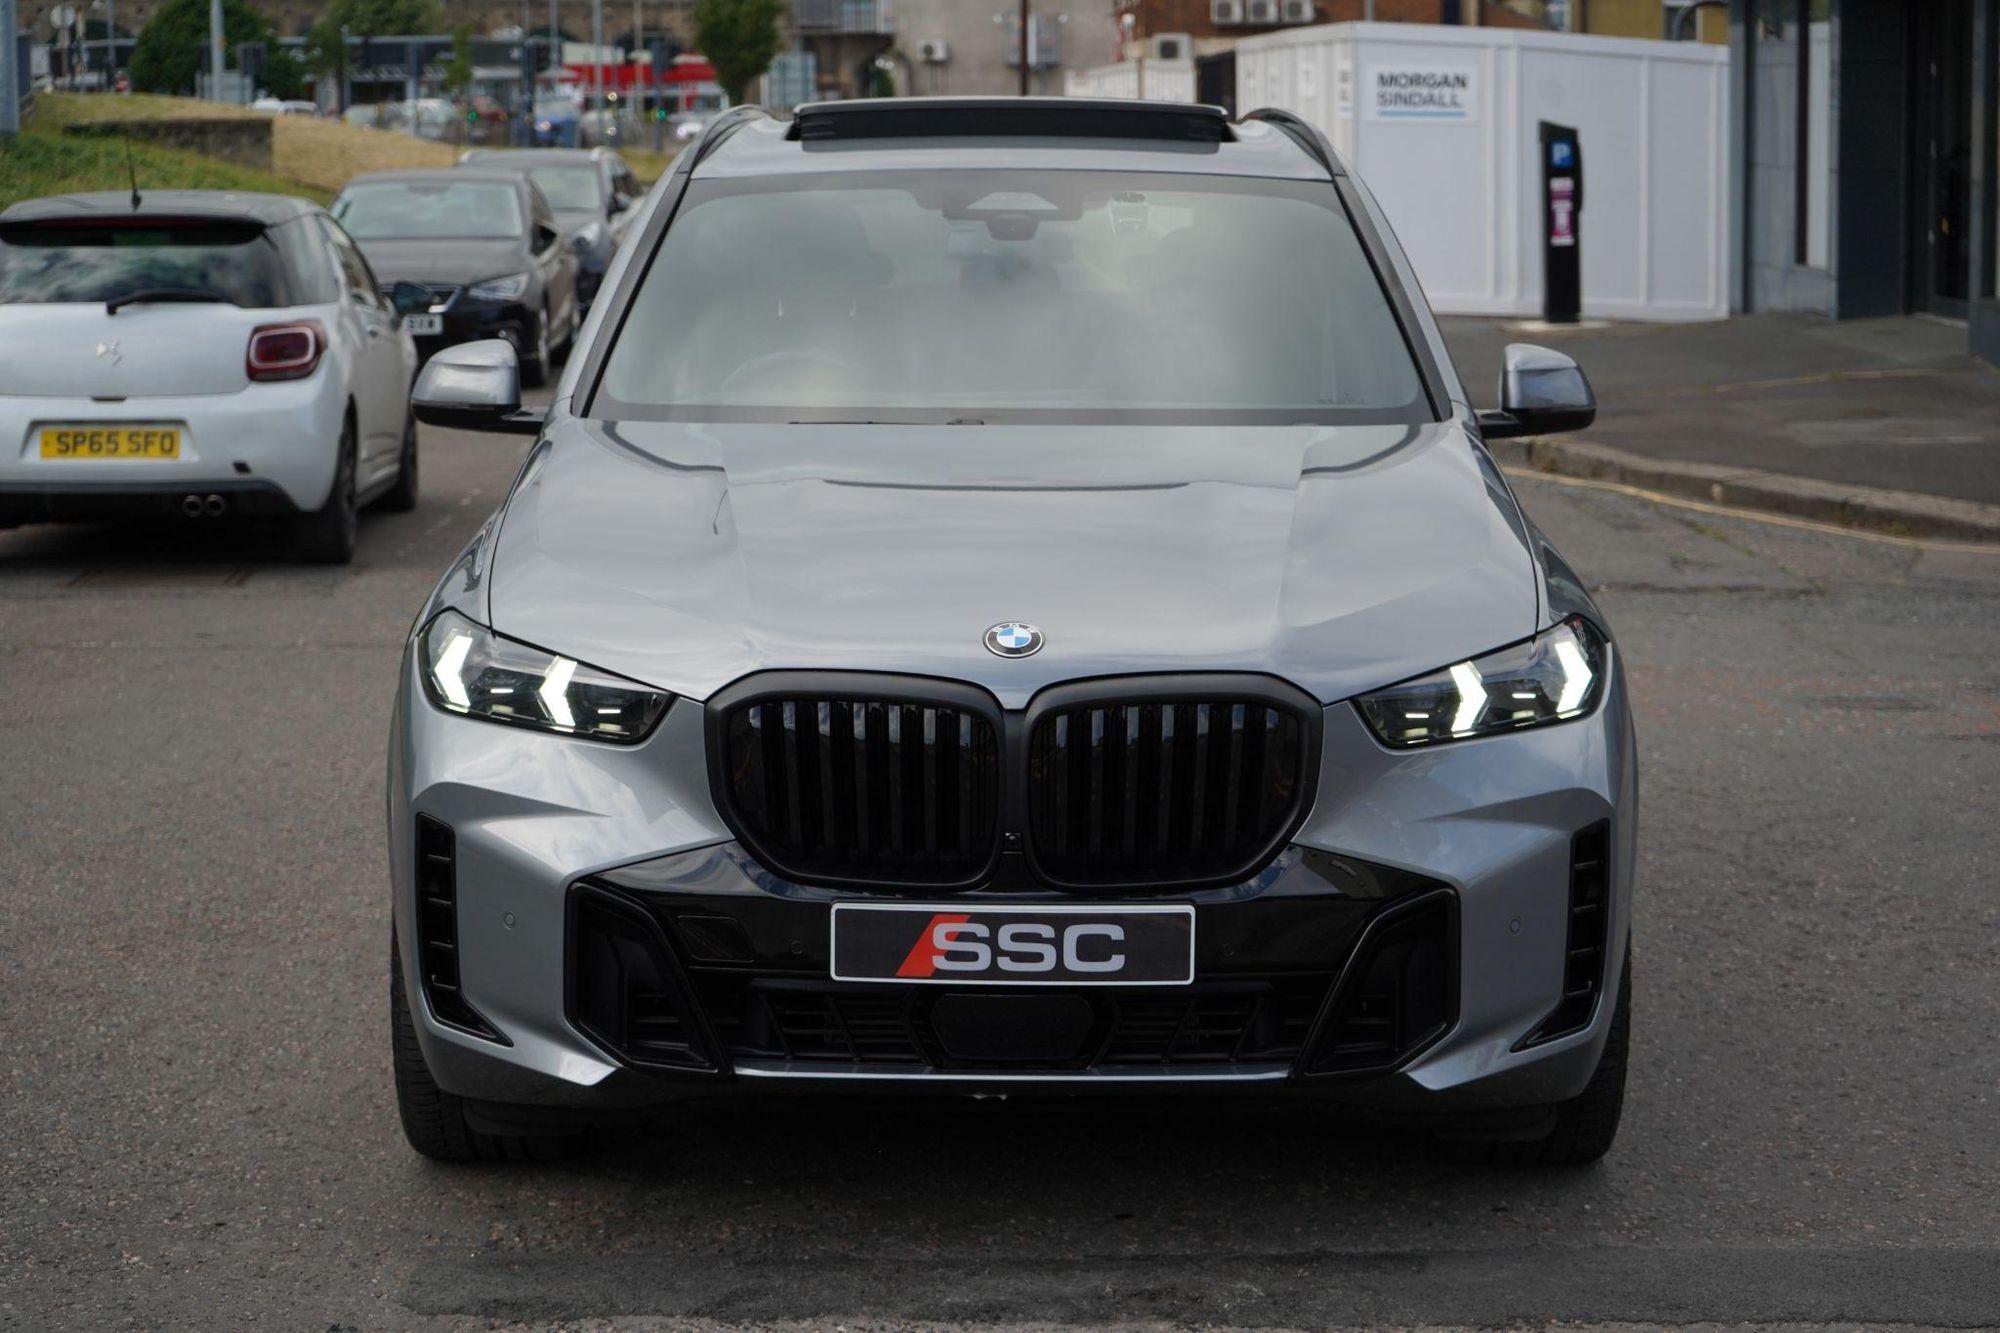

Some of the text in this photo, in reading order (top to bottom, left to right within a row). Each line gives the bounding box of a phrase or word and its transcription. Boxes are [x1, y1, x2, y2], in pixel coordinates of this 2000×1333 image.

[1376, 72, 1467, 89] MORGAN
[1376, 90, 1463, 108] SINDALL
[1552, 143, 1571, 165] P
[56, 431, 175, 454] SP65 SFO
[932, 922, 1126, 973] SSC
